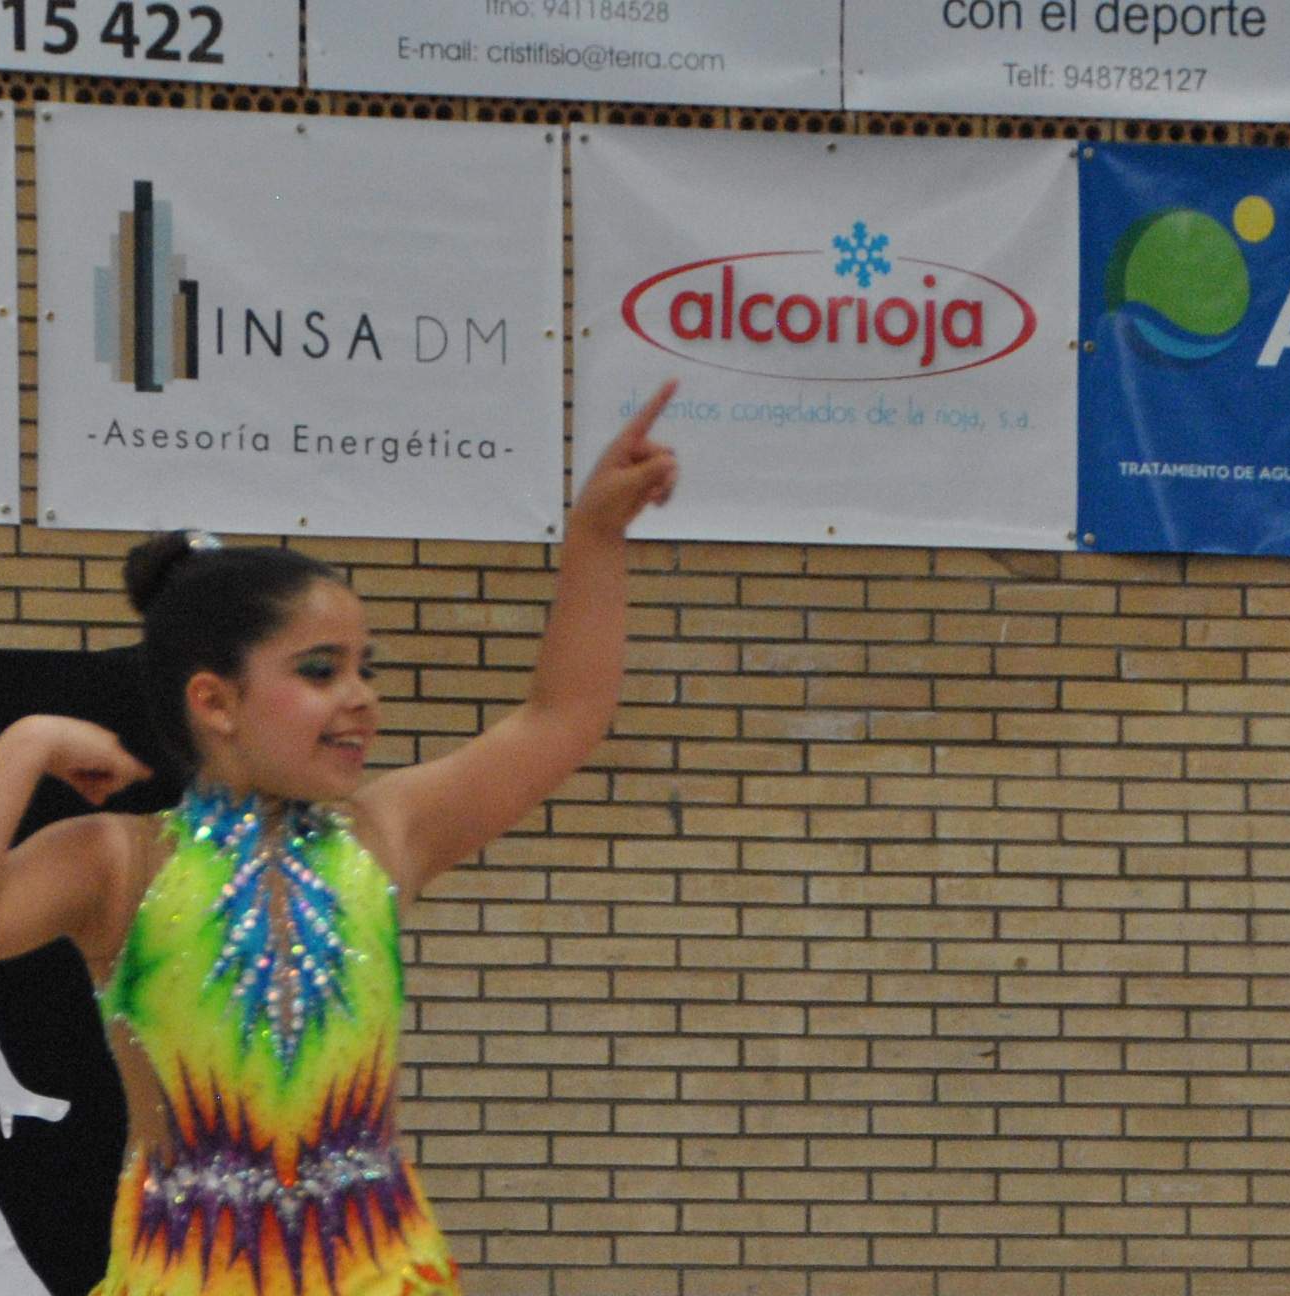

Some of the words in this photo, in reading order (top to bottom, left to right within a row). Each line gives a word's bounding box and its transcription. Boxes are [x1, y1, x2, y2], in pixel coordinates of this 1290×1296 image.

[100, 1, 225, 64] 422
[942, 0, 1023, 30] con
[1040, 0, 1078, 32] el
[1094, 0, 1267, 45] deporte
[397, 36, 478, 62] E-mail:
[486, 41, 726, 72] cristifisio@terra.com
[1003, 63, 1055, 88] Telf:
[1064, 65, 1208, 91] 948782127
[215, 306, 384, 361] INSA
[414, 315, 508, 365] DM
[669, 264, 984, 368] alcorioja
[729, 387, 857, 428] congelados
[865, 391, 898, 426] de
[907, 393, 925, 426] la
[1118, 460, 1230, 480] TRATAMIENTO
[1232, 464, 1256, 481] DE
